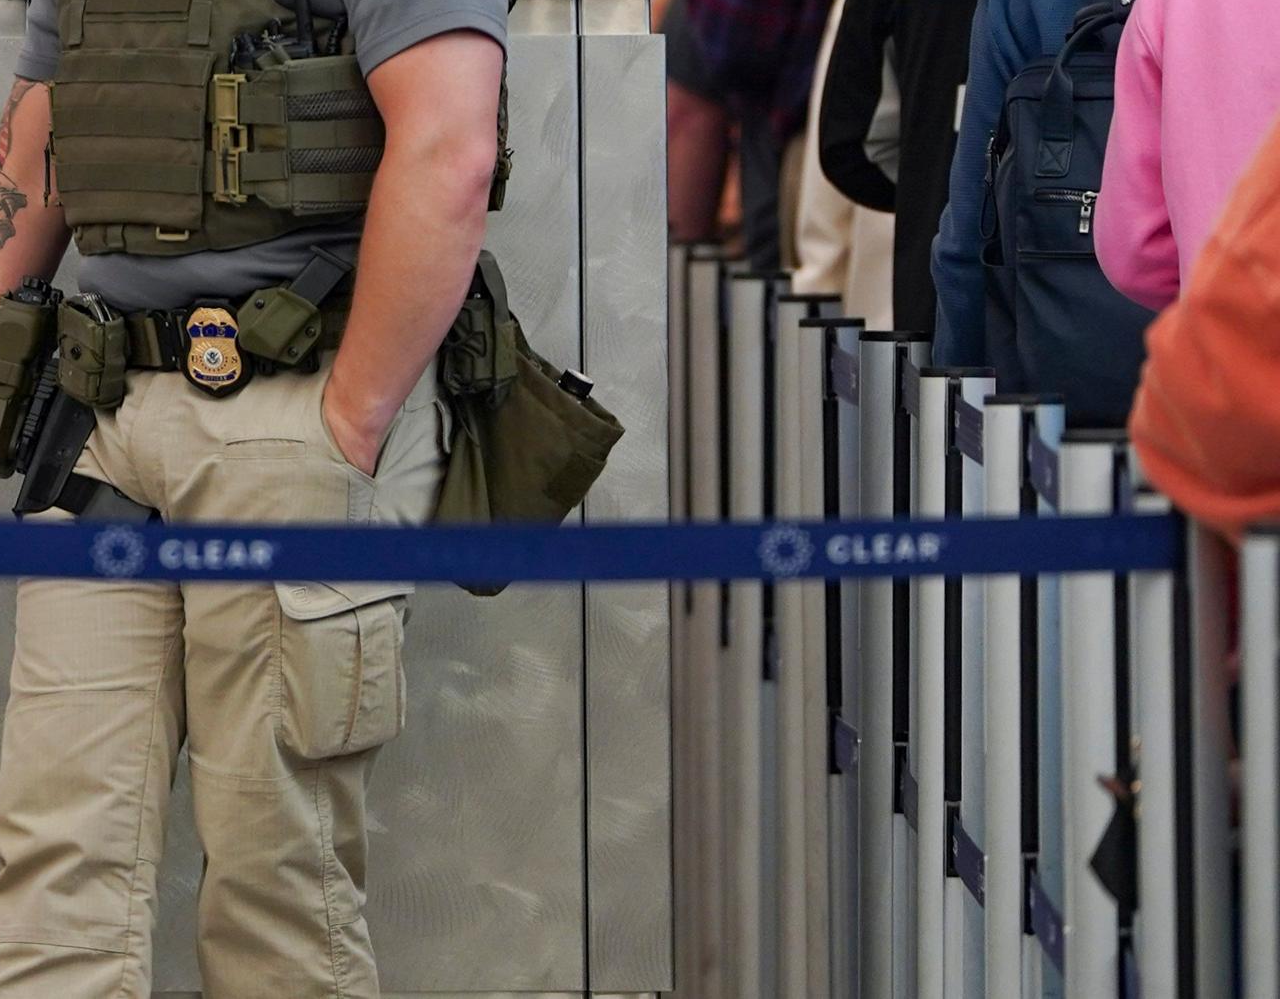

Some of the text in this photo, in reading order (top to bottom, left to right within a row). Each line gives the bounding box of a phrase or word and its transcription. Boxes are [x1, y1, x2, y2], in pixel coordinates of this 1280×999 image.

[191, 354, 238, 364] U S
[159, 539, 273, 569] CLEAR
[826, 532, 940, 564] CLEAR
